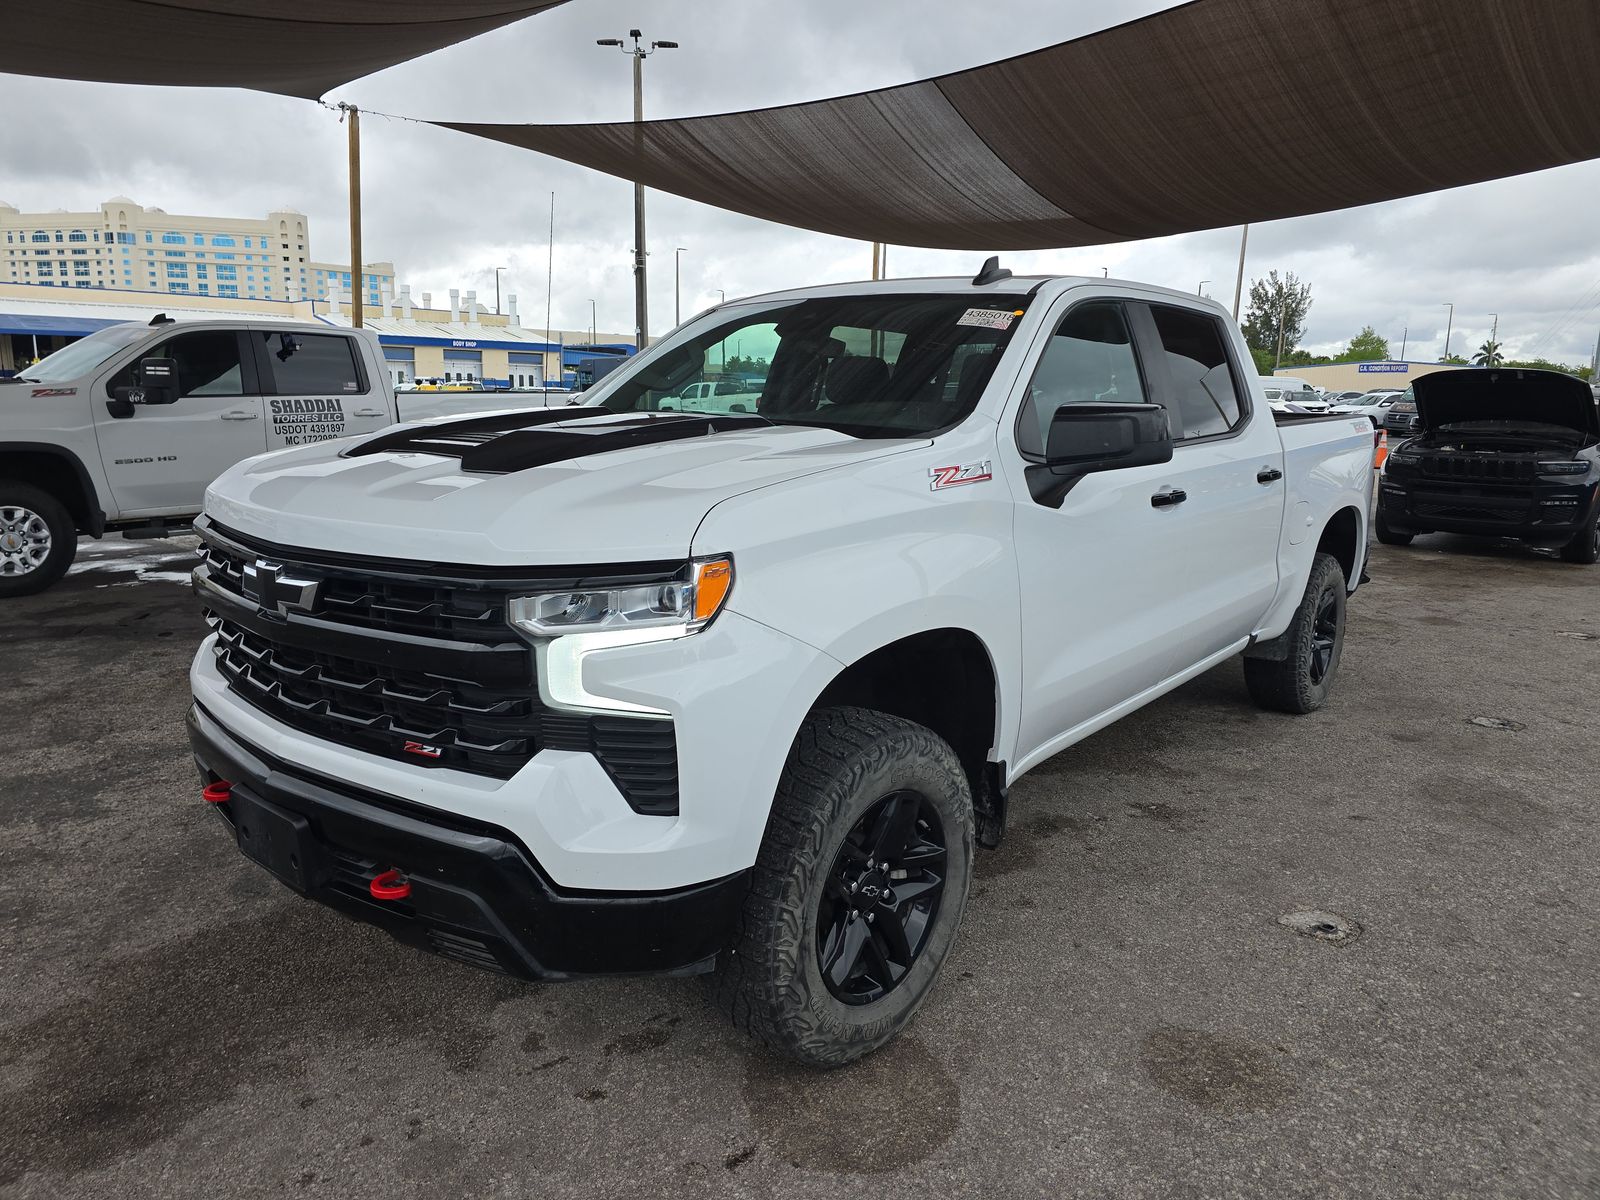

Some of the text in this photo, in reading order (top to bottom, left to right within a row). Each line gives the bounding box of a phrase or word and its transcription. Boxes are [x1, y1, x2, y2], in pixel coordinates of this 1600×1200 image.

[966, 310, 1016, 321] 4385018
[31, 388, 78, 397] Z71
[270, 399, 343, 414] SHADDAI
[275, 413, 341, 423] TORRES LLC
[274, 424, 345, 435] USDOT 4391897
[285, 435, 300, 445] MC
[114, 457, 154, 465] 2500
[927, 460, 993, 492] Z71
[403, 740, 442, 759] Z71
